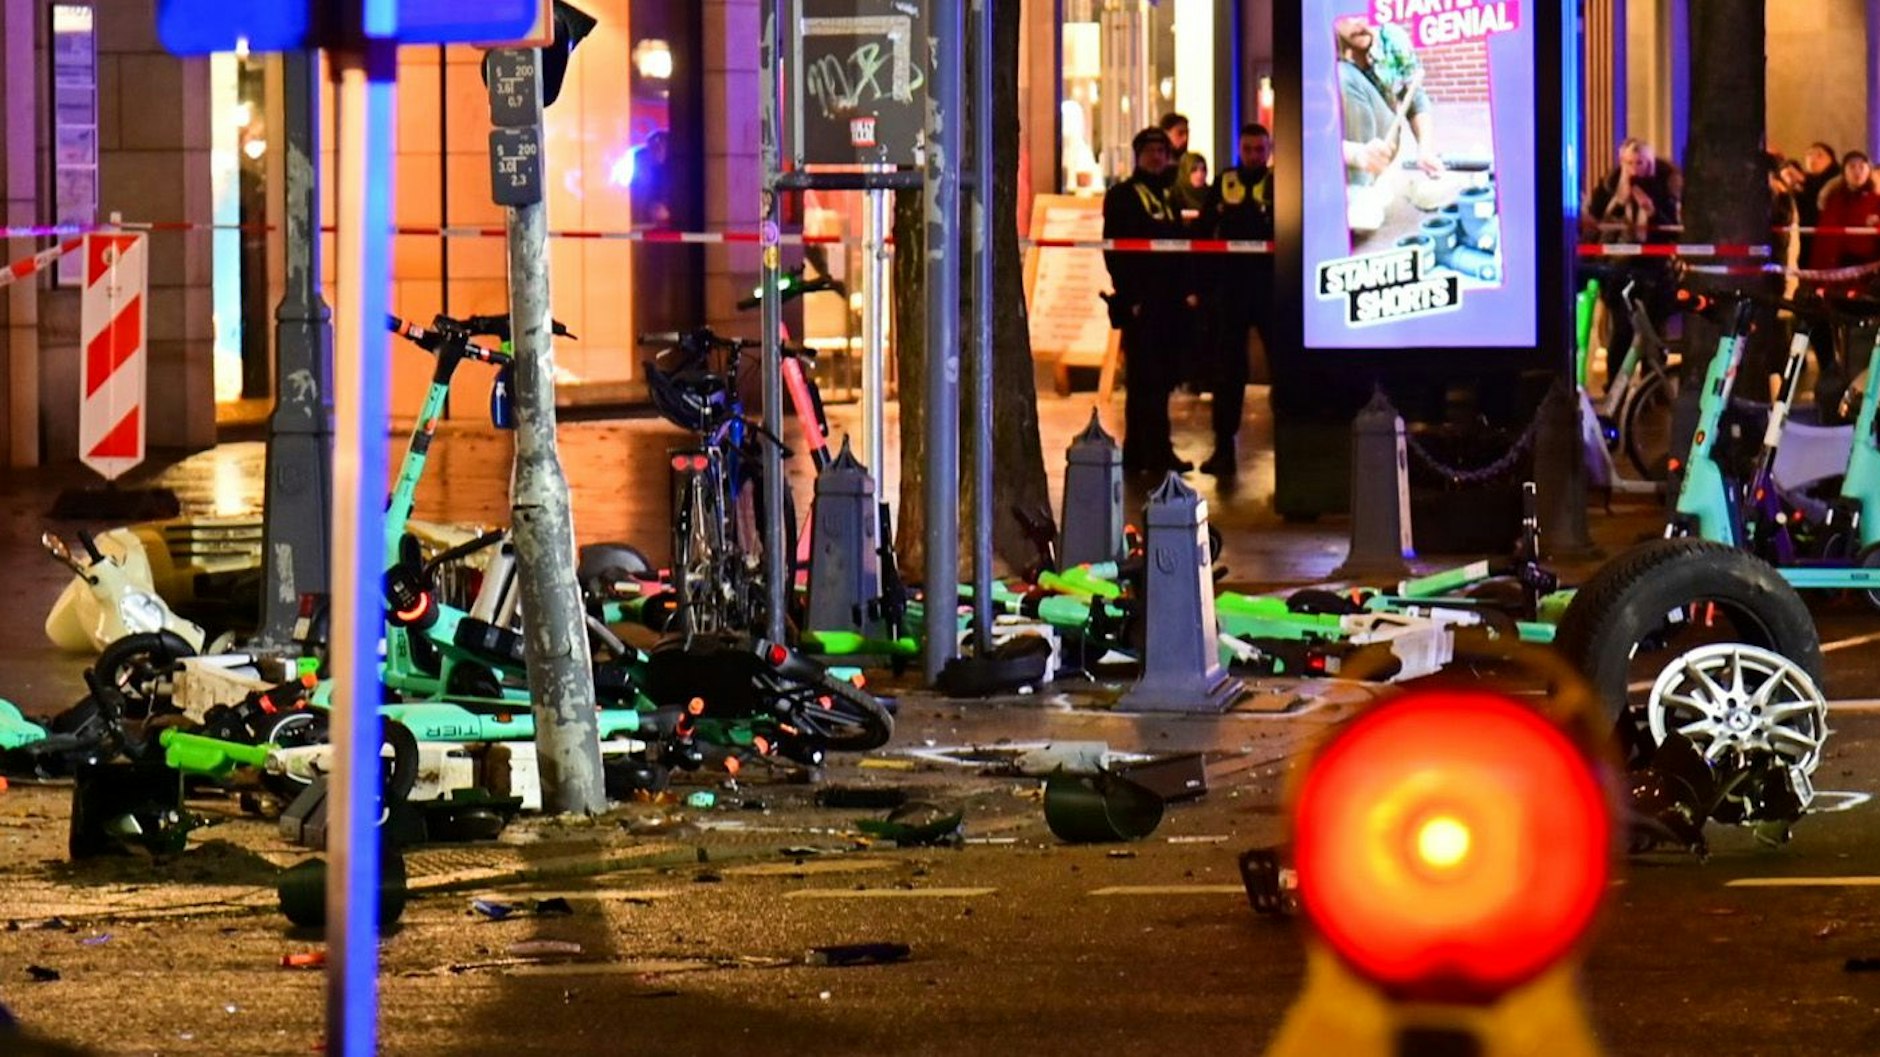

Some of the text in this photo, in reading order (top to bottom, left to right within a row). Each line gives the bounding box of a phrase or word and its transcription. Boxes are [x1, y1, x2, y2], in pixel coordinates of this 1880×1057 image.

[1418, 2, 1514, 46] GENIAL
[515, 65, 534, 76] 200
[508, 95, 523, 107] 0.7
[518, 143, 537, 156] 200
[511, 174, 526, 186] 2.3
[1325, 251, 1414, 293] STARTE
[1356, 279, 1450, 320] SHORTS
[425, 725, 479, 737] TIER
